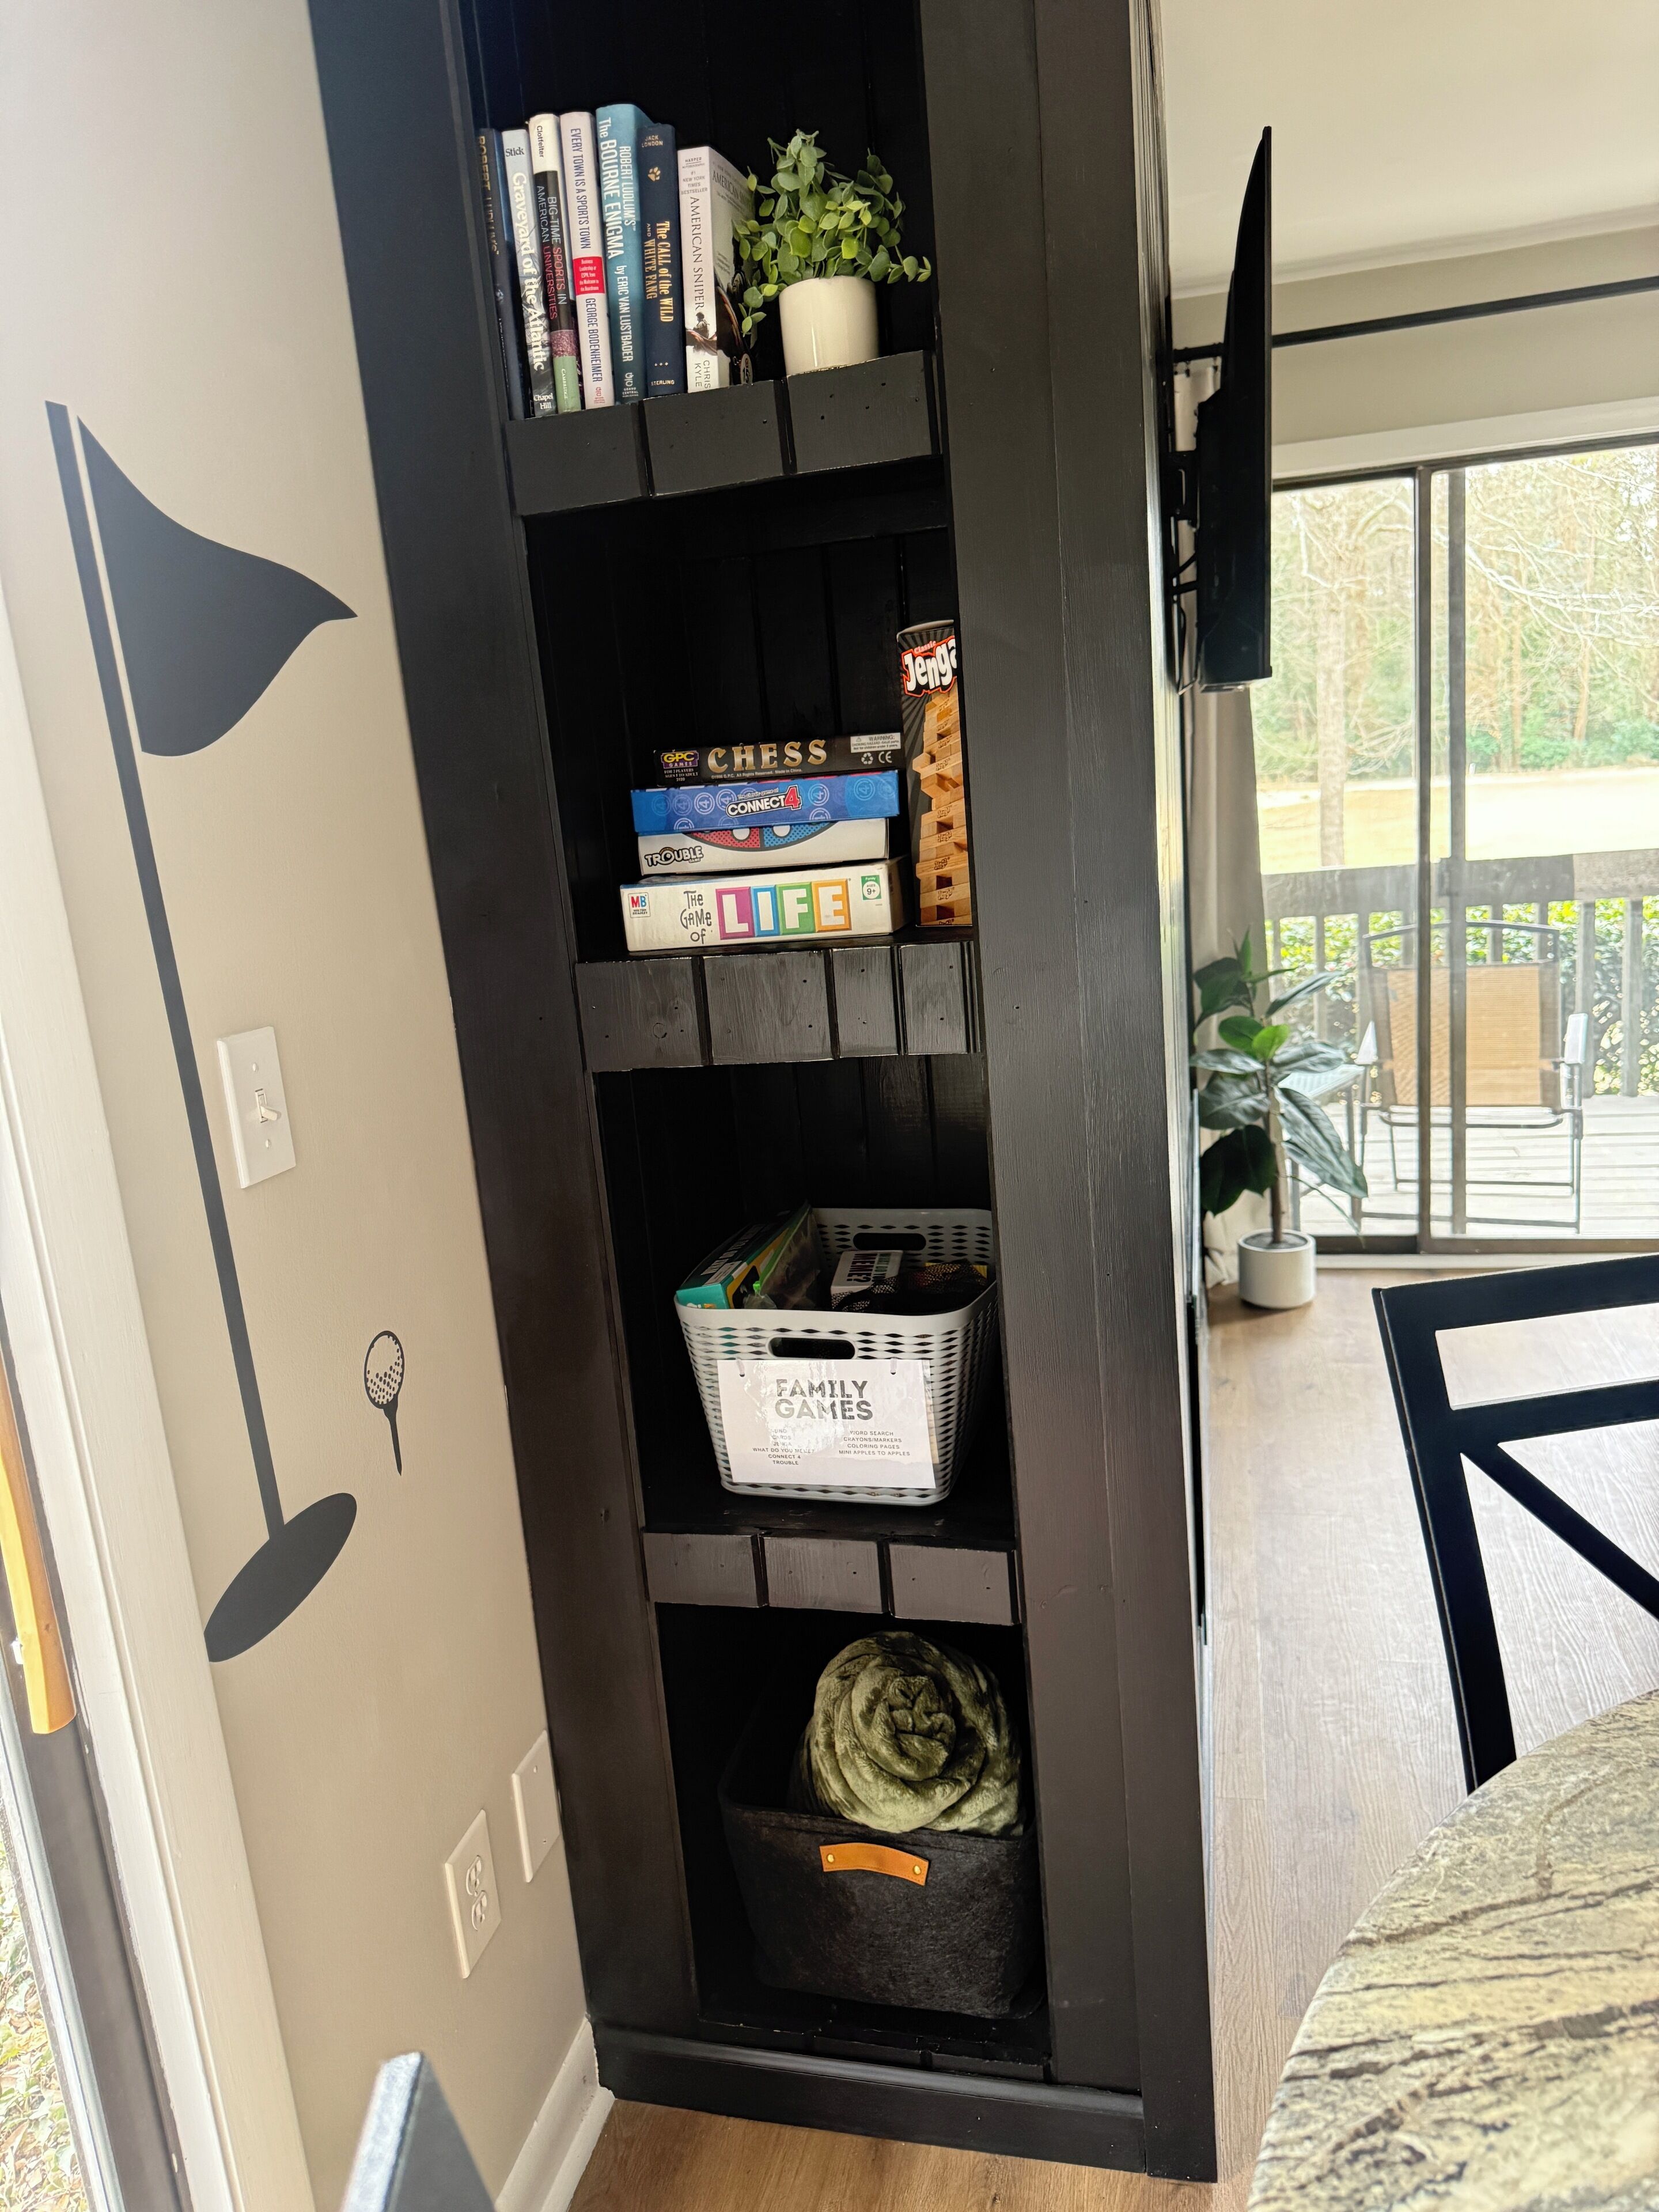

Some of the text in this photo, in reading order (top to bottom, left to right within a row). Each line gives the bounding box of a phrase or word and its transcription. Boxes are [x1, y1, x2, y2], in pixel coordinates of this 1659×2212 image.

[505, 146, 524, 157] Stick
[571, 128, 581, 151] EVERY
[573, 153, 584, 175] TOWN
[619, 146, 632, 180] ROBERT
[575, 175, 585, 186] IS
[599, 117, 624, 259] The BOURNE ENIGMA
[576, 195, 589, 225] SPORTS
[536, 185, 558, 320] AMERICAN UNIVERSITIES
[548, 196, 567, 305] BIG-TIME SPORTS IN
[578, 226, 591, 249] TOWN
[690, 197, 704, 309] AMERICAN SNIPER
[513, 172, 547, 371] Graveyard of the Atlantic
[644, 238, 657, 300] WHITE FANG
[656, 221, 673, 322] The CALL of the WILD
[585, 298, 598, 327] GEORGE
[614, 265, 634, 362] by ERIC VAN LUSTBADER
[588, 329, 603, 382] BODENHEIMER
[533, 393, 554, 402] Chapel
[664, 752, 695, 763] GPC
[707, 740, 827, 773] CHESS
[728, 786, 800, 816] CONNECT 4
[645, 847, 703, 867] TROUBLE
[631, 896, 646, 908] MB
[720, 883, 847, 935] LIFE
[847, 1253, 877, 1282] MEME?
[776, 1379, 868, 1399] FAMILY
[775, 1399, 873, 1421] GAMES
